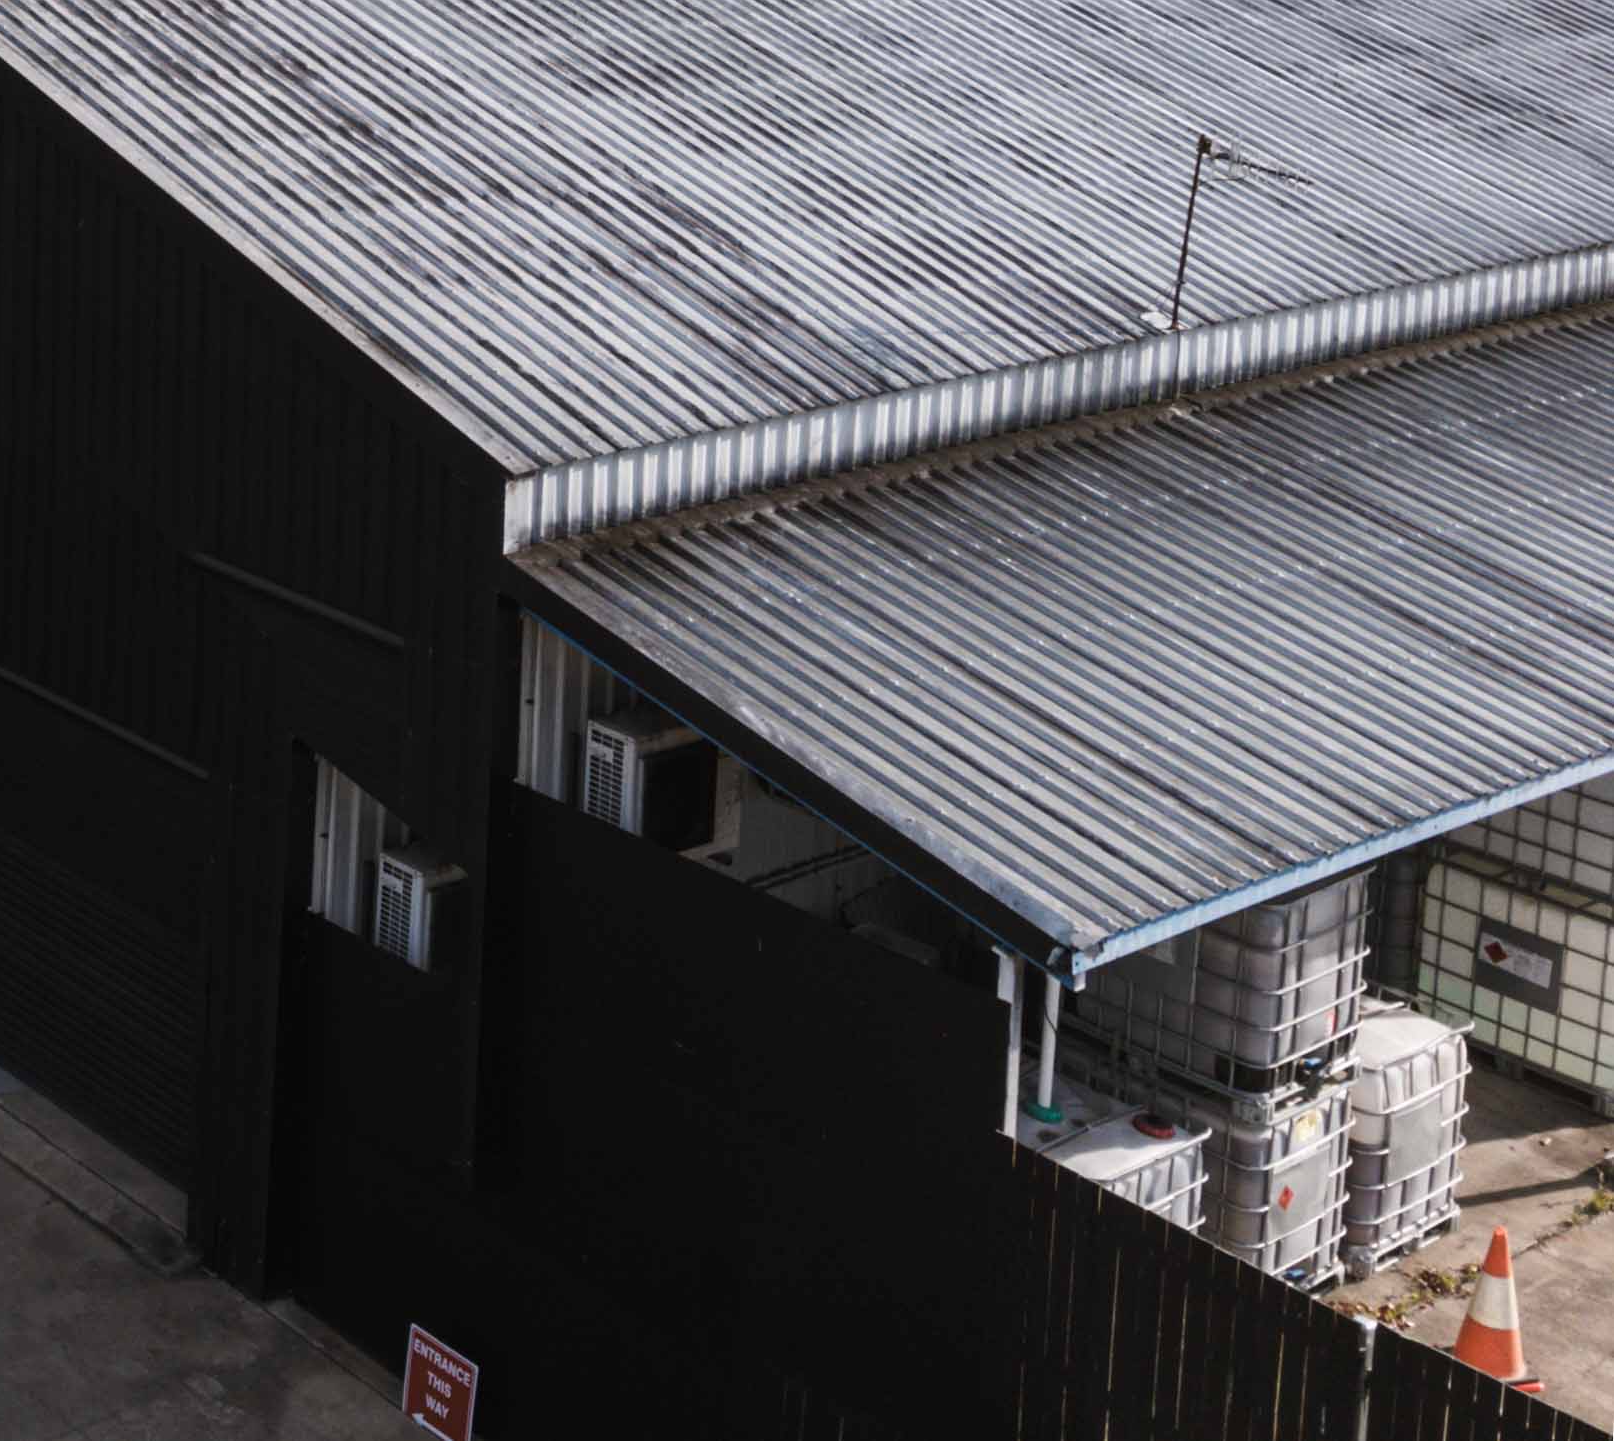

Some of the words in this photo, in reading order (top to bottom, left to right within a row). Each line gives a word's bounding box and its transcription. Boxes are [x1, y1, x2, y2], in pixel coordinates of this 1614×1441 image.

[413, 1338, 471, 1388] ENTRANCE
[427, 1371, 452, 1398] THIS
[425, 1393, 450, 1420] WAY
